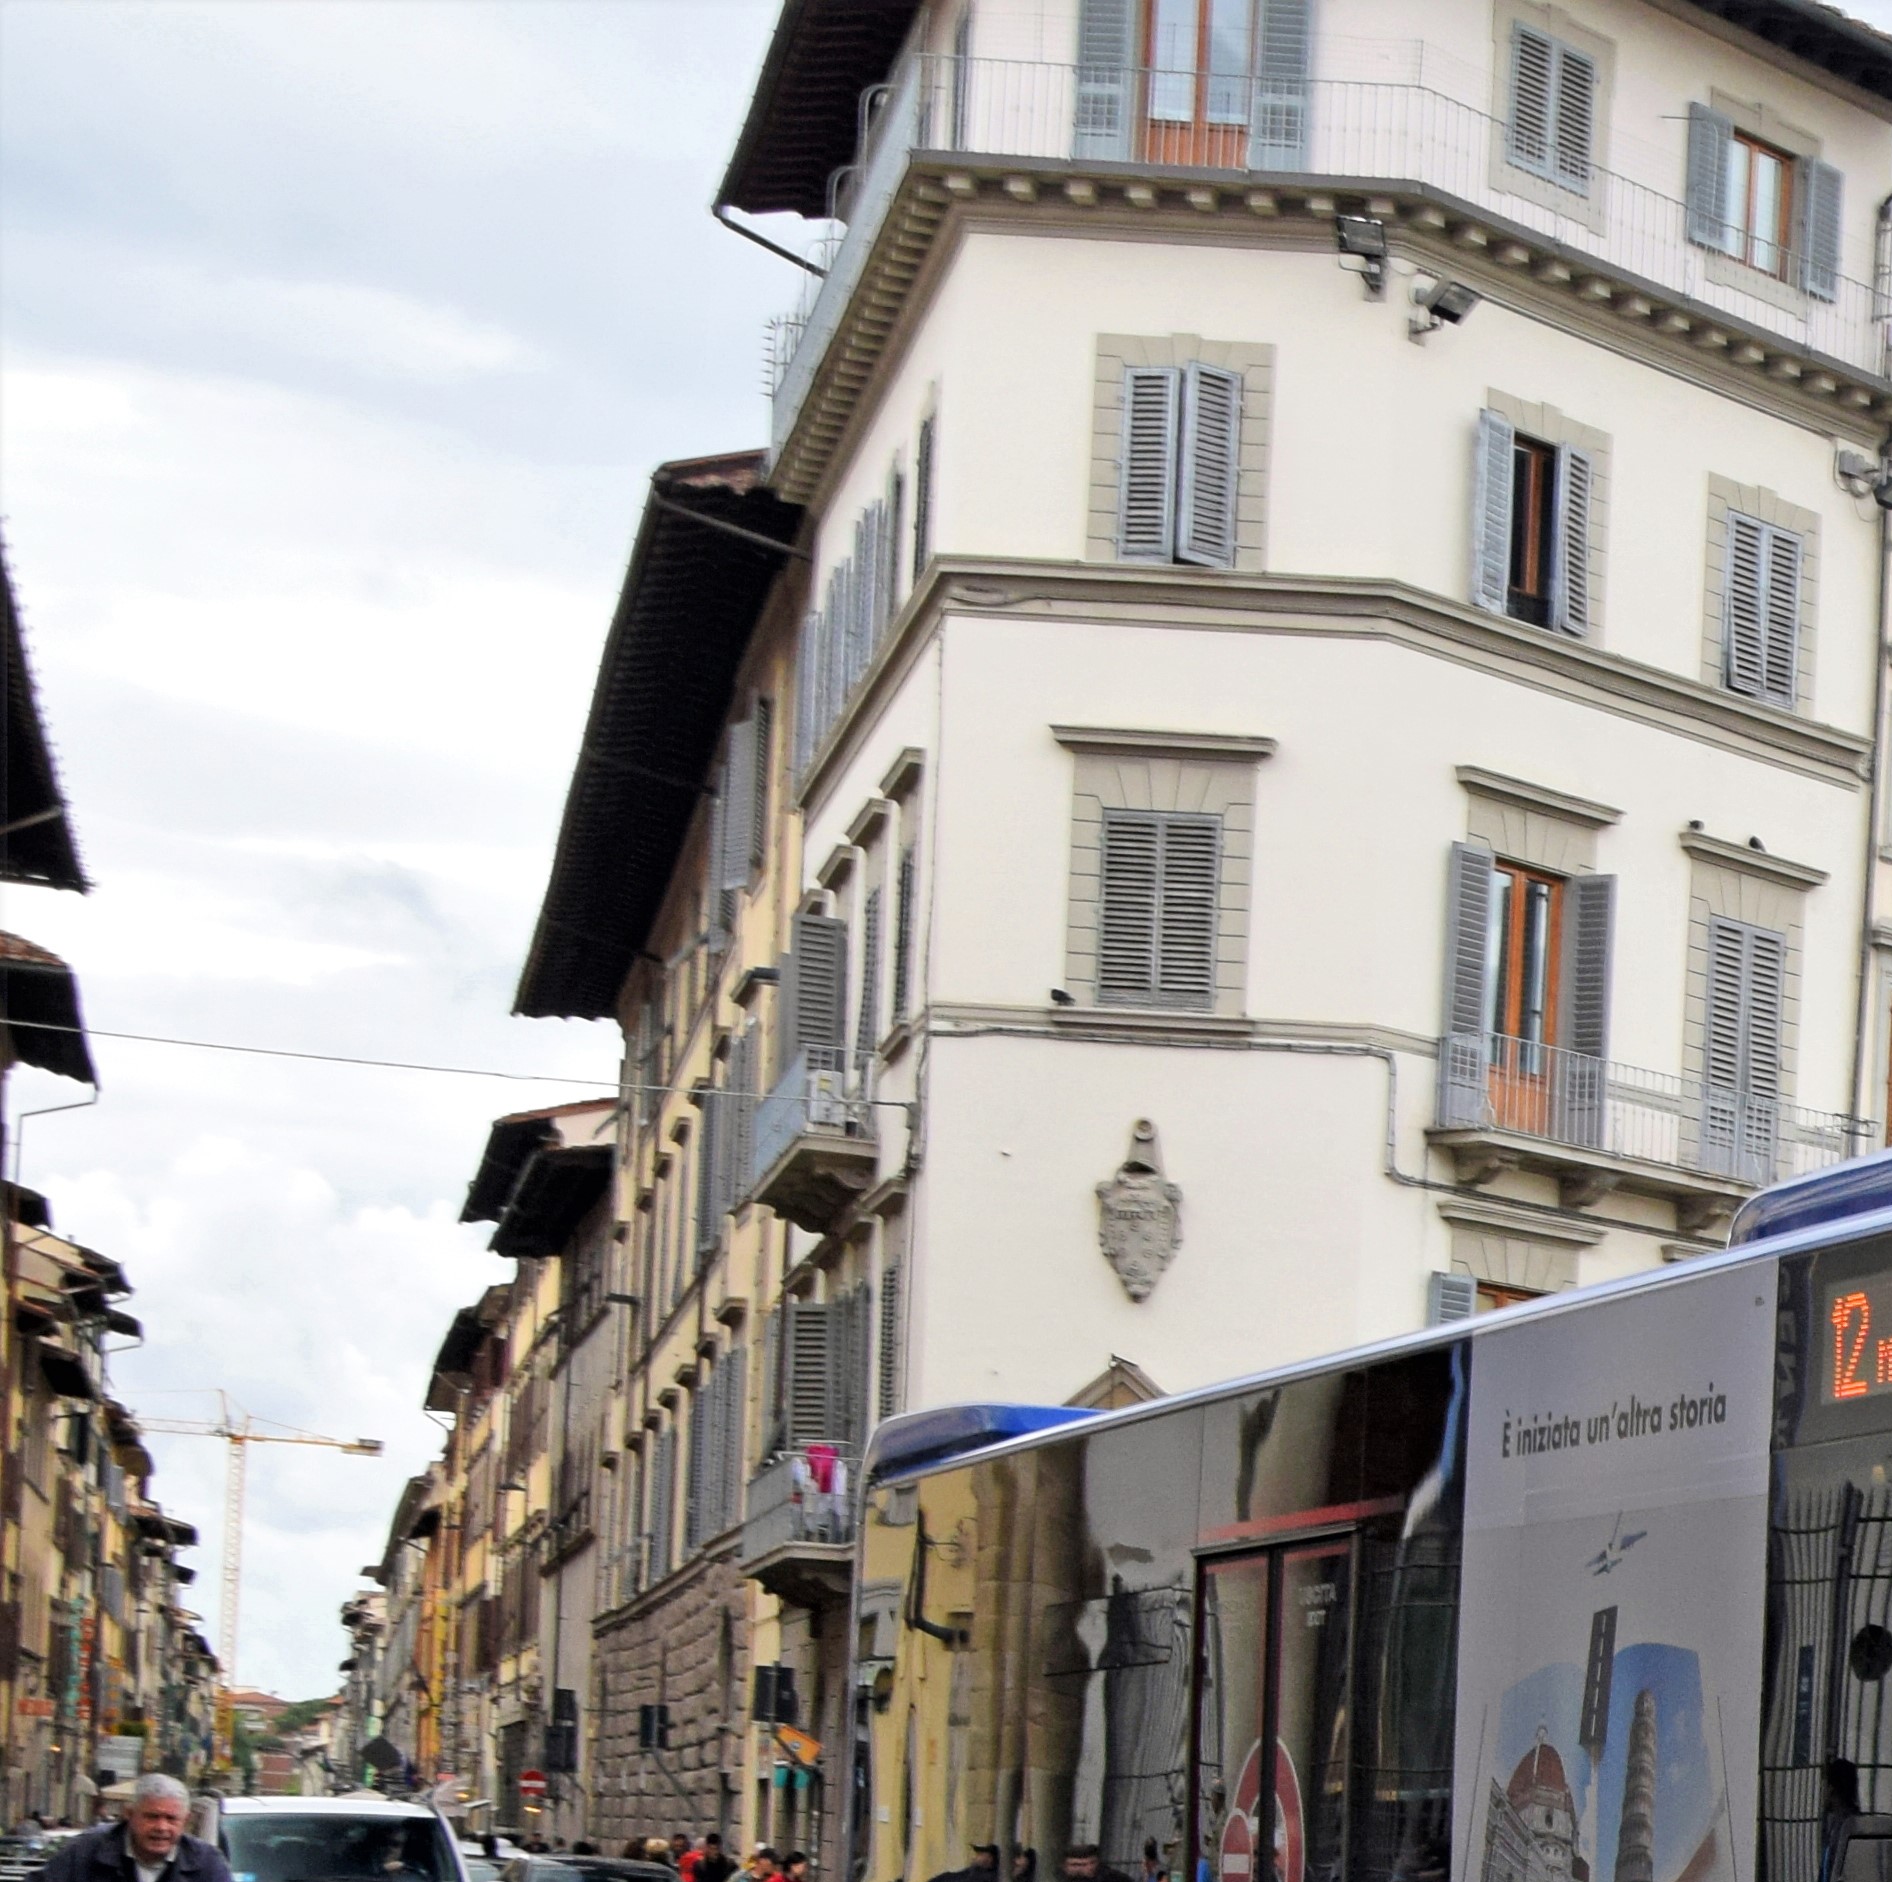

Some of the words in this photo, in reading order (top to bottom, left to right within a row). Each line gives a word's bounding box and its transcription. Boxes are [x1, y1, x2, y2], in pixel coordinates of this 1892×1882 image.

[1831, 1291, 1870, 1399] 12
[1501, 1409, 1512, 1458] È
[1516, 1411, 1581, 1456] iniziata
[1587, 1394, 1663, 1445] un'altra
[1668, 1381, 1727, 1431] storia
